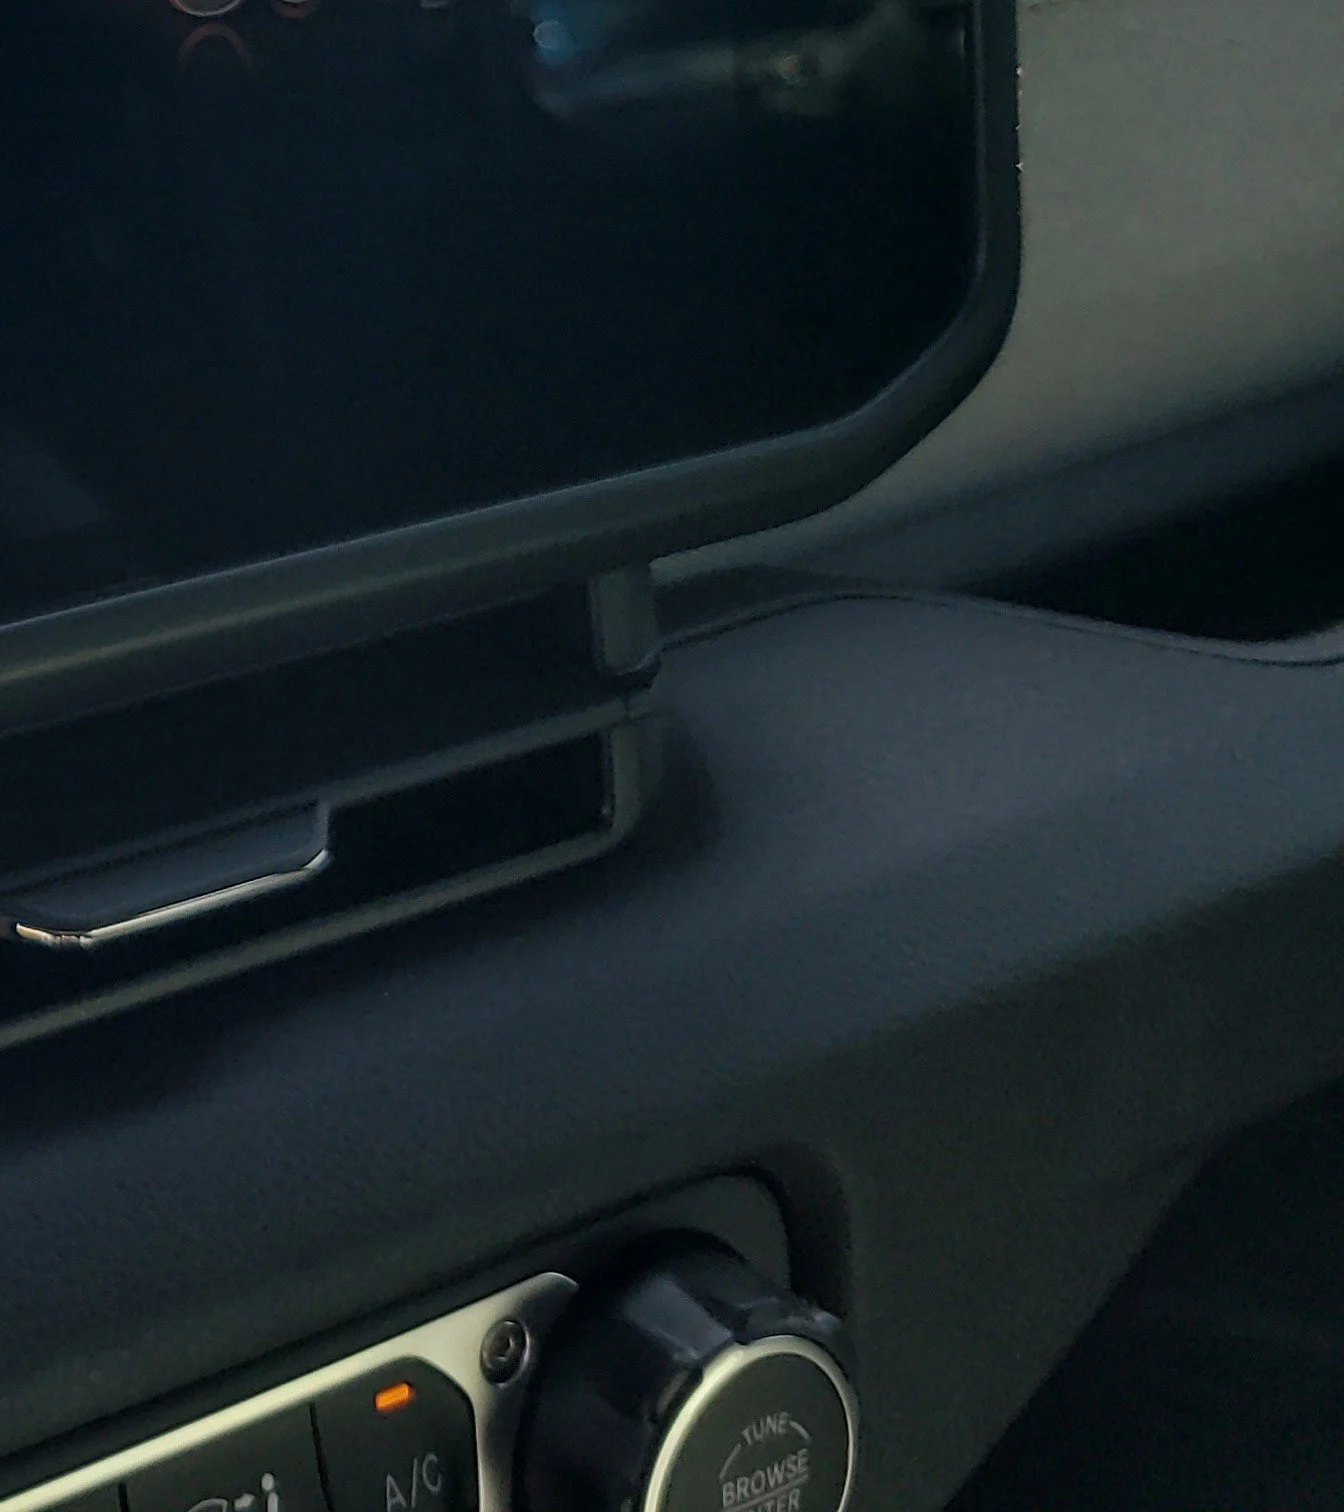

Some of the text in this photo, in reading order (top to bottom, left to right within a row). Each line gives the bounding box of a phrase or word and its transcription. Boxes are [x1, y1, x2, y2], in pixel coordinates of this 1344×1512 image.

[742, 1412, 790, 1444] TUNE
[386, 1452, 443, 1512] A/C
[722, 1448, 810, 1508] BROWSE
